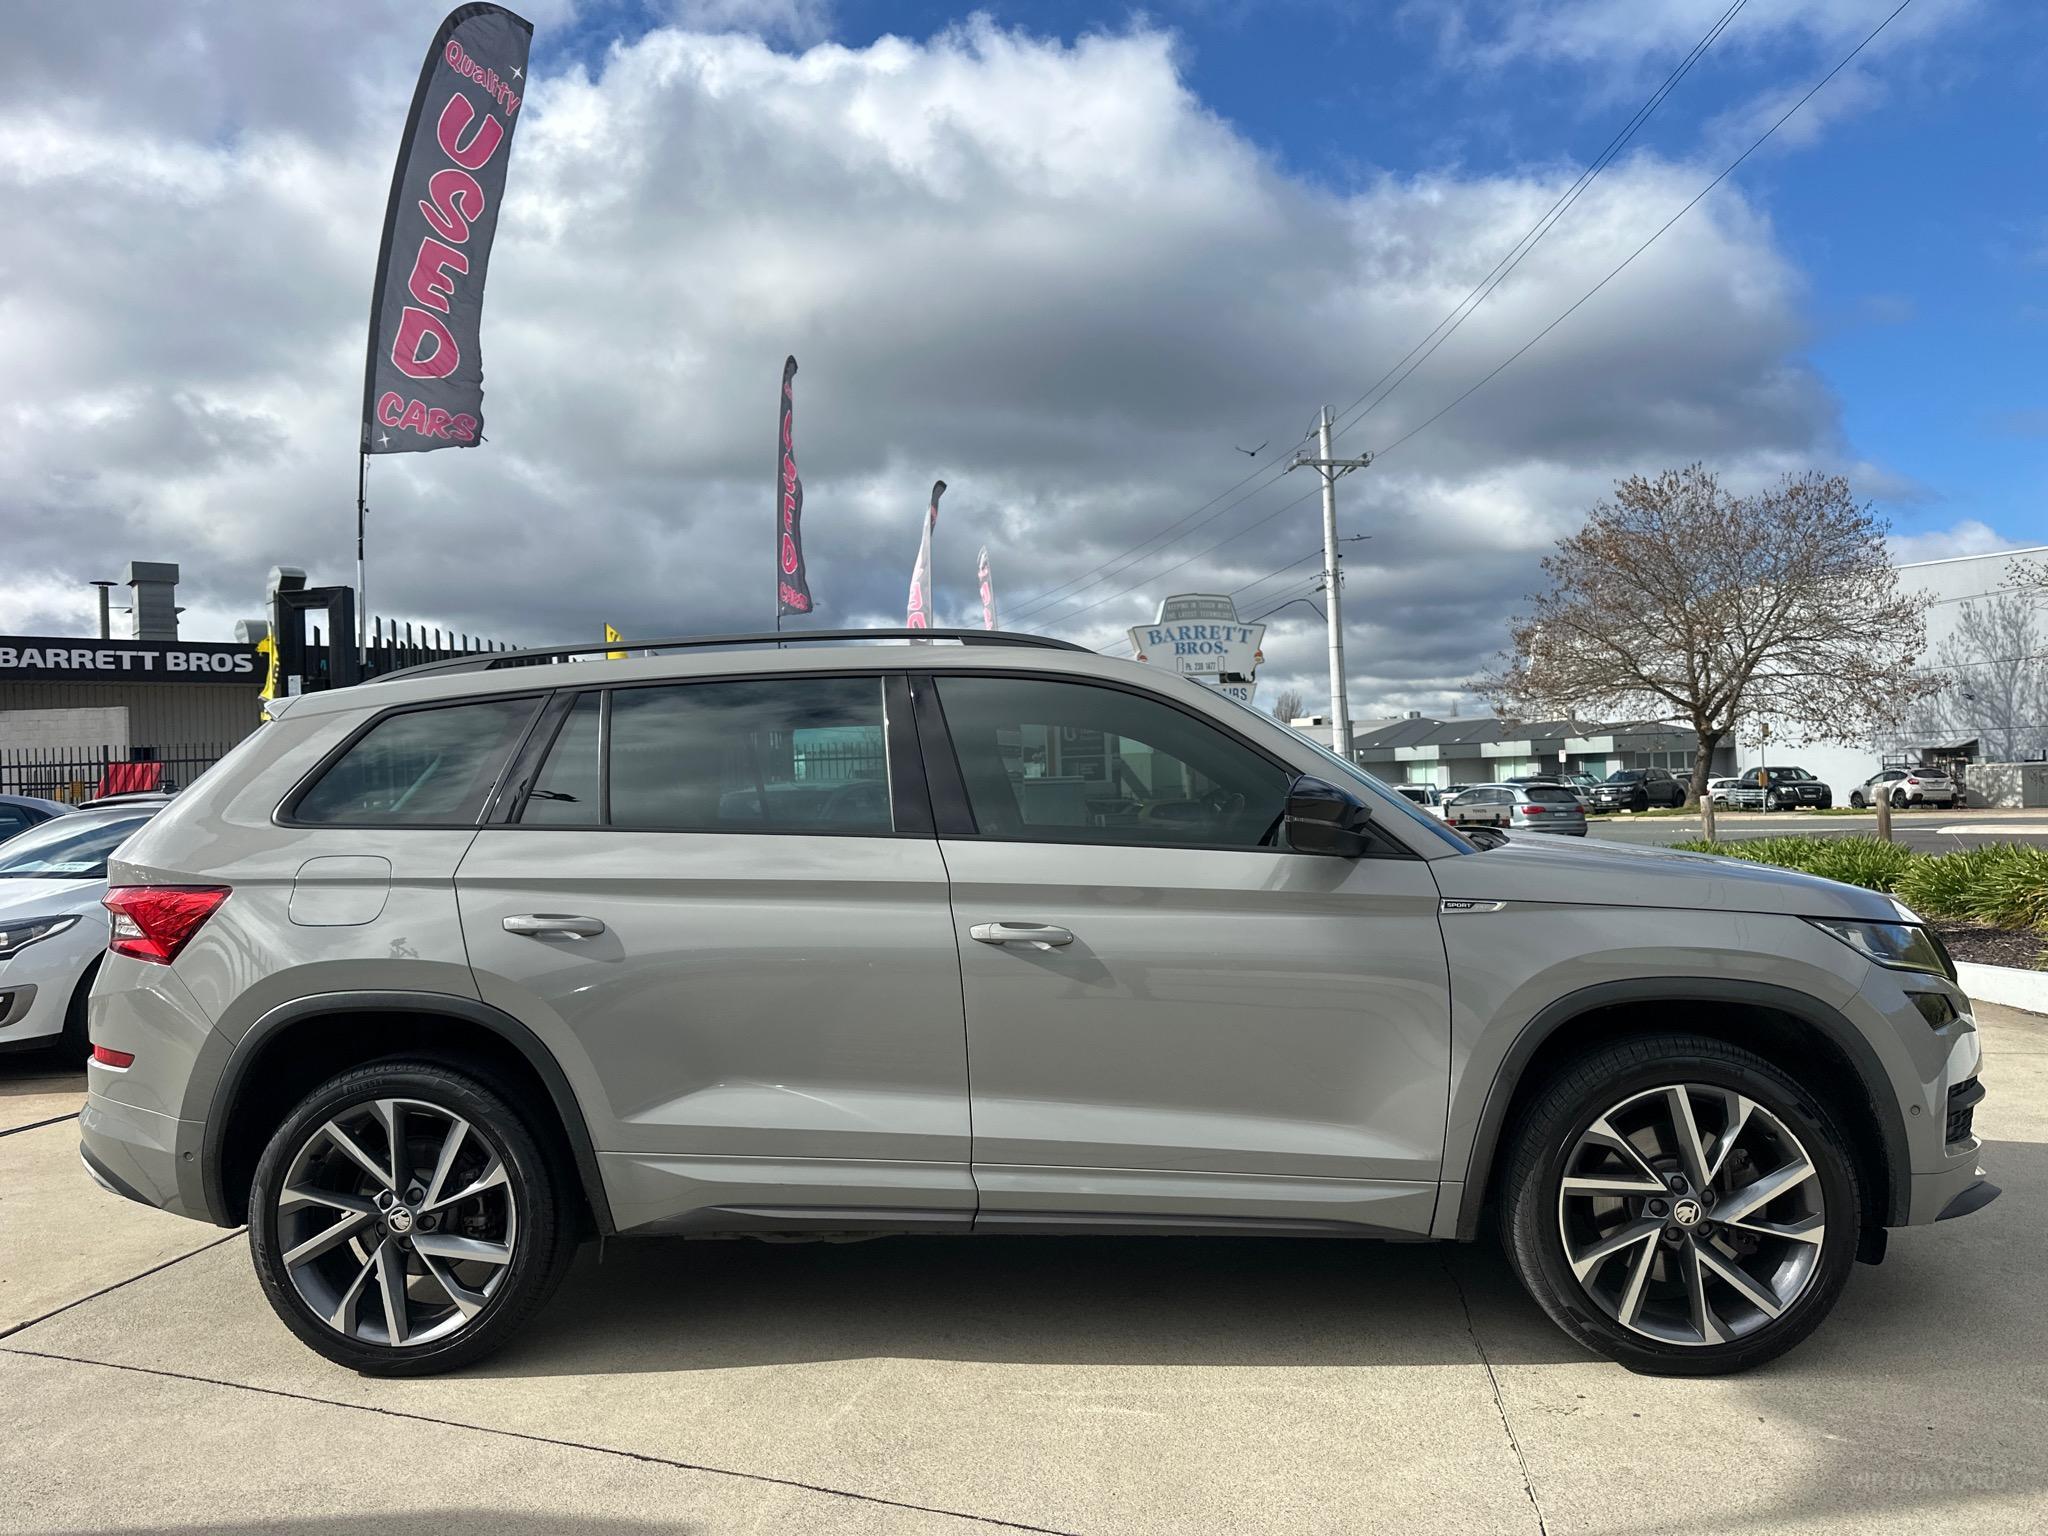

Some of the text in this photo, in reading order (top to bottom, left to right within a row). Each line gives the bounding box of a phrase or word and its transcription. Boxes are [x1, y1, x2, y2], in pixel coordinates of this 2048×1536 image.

[444, 39, 521, 116] Quality
[391, 92, 504, 379] USED
[377, 391, 478, 441] CARS
[1147, 624, 1253, 646] BARRETT
[1174, 641, 1228, 655] BROS.
[0, 648, 159, 670] BARRETT
[166, 651, 254, 673] BROS
